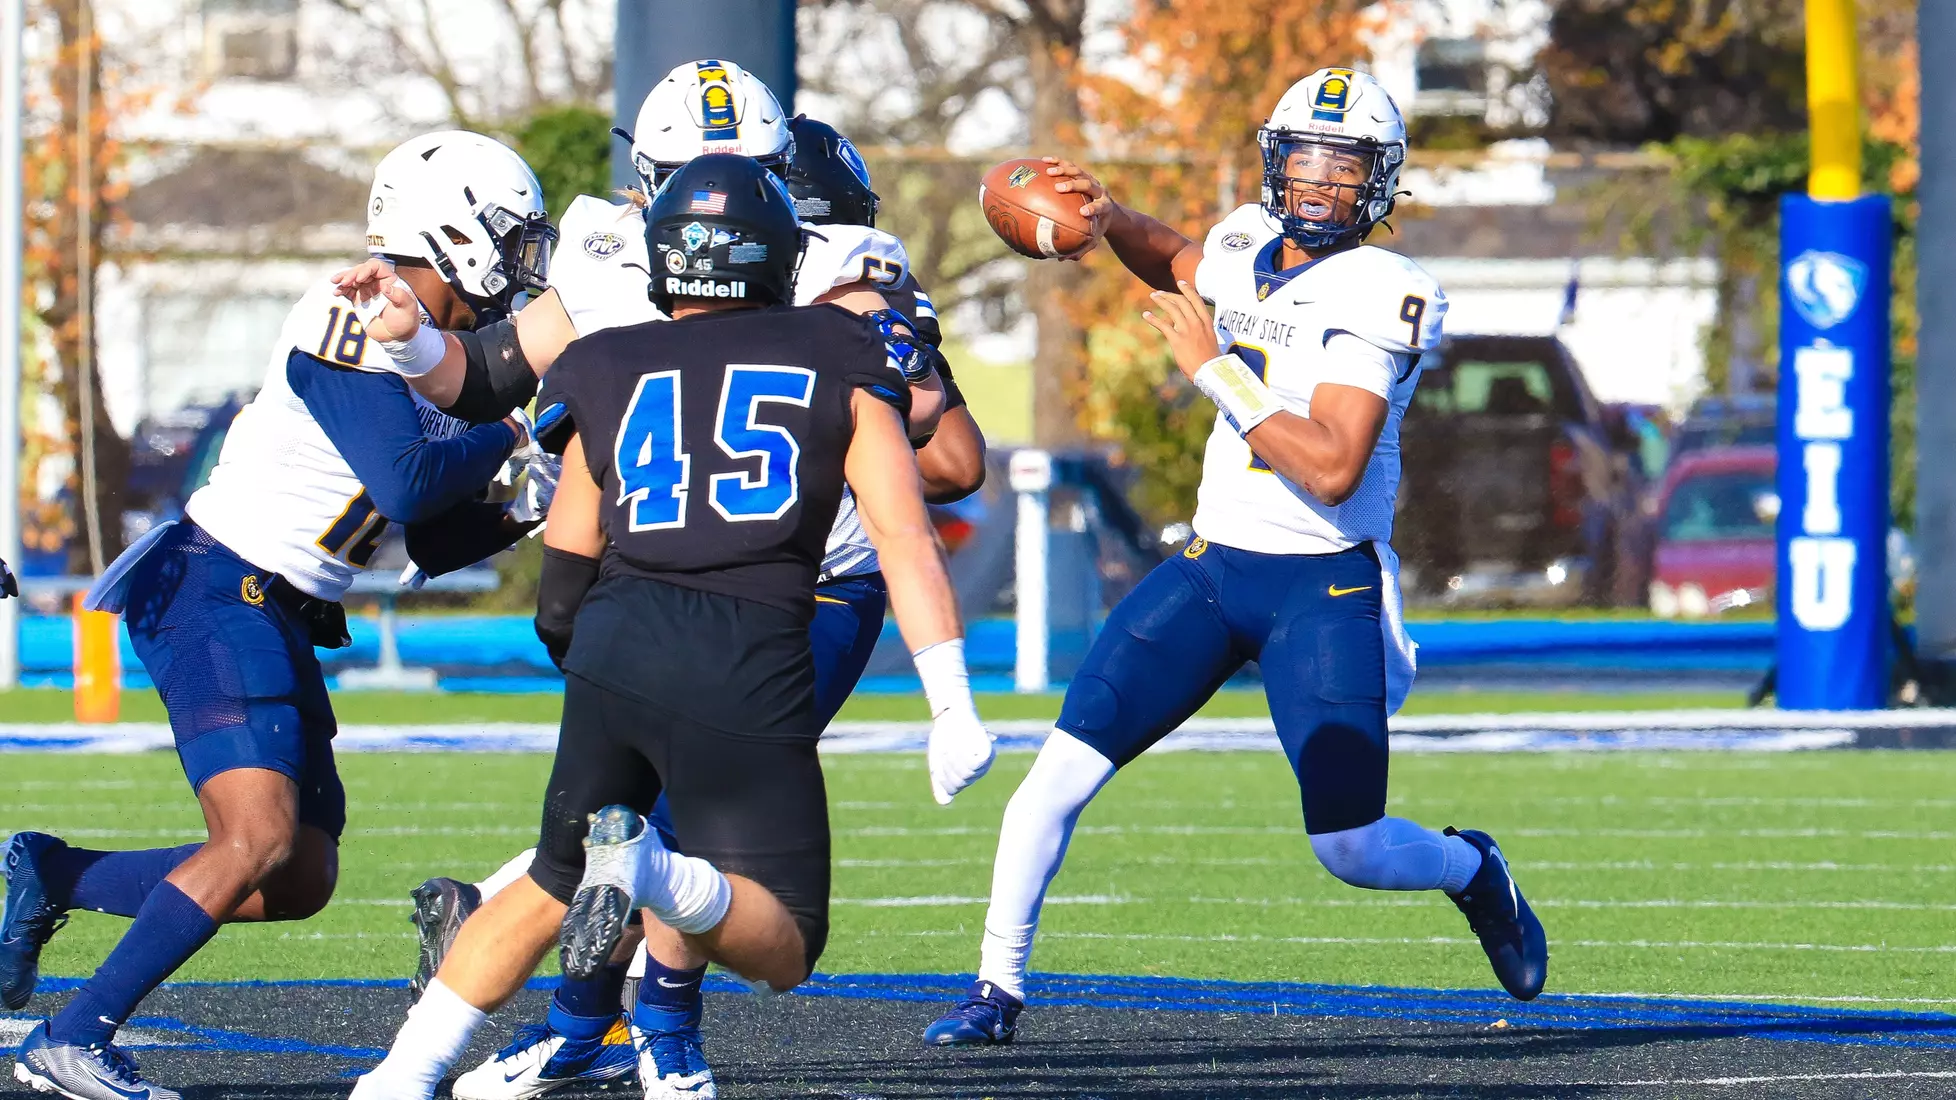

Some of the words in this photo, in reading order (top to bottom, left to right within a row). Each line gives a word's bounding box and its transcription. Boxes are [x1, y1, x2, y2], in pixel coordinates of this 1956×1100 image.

[1308, 123, 1344, 134] Riddell
[702, 144, 742, 155] Riddell
[695, 258, 713, 271] 45
[666, 277, 746, 298] Riddell
[318, 306, 367, 366] 18
[1216, 308, 1259, 336] MURRAY
[1259, 318, 1296, 348] STATE
[1399, 293, 1428, 347] 9
[417, 405, 455, 438] URRAY
[614, 363, 817, 533] 45
[1788, 347, 1857, 632] EIU
[26, 1050, 47, 1072] VAPOR
